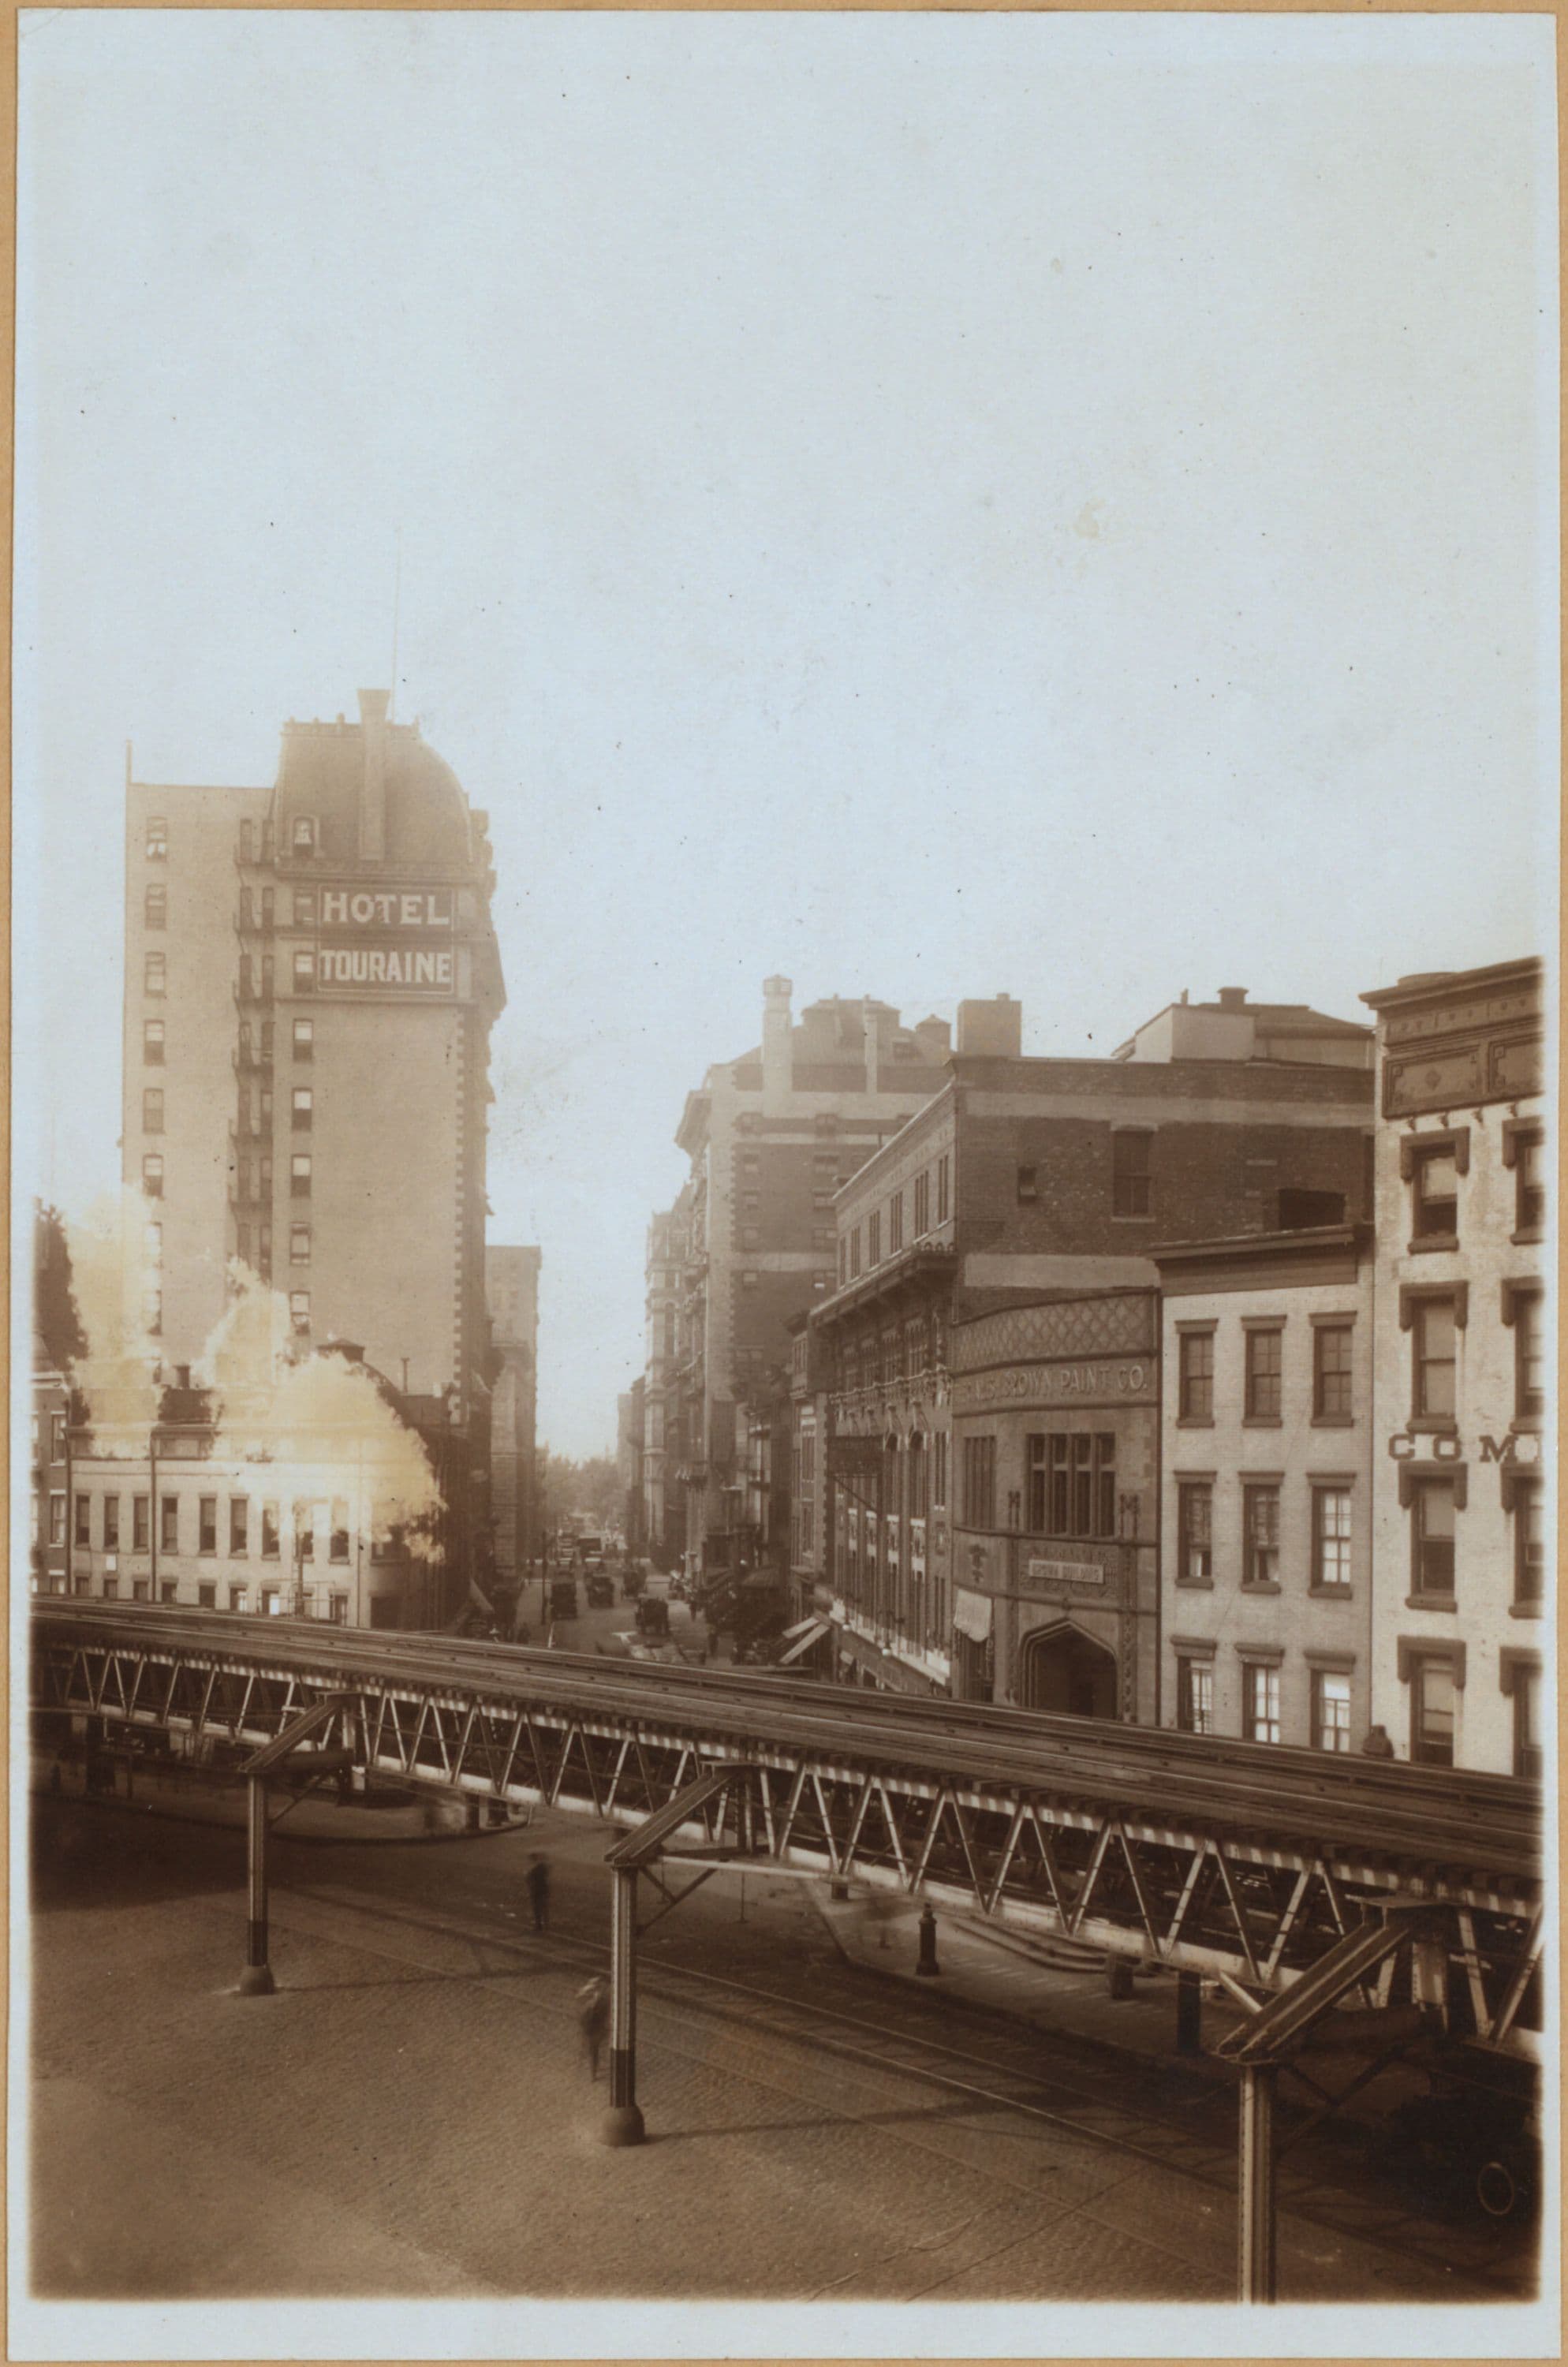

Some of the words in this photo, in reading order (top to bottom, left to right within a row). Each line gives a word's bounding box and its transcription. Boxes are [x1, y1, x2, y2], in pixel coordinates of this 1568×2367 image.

[323, 892, 449, 925] HOTEL
[320, 950, 452, 984] TOURAINE
[1060, 1367, 1110, 1395] PAINT
[1117, 1365, 1148, 1392] CO.
[1388, 1433, 1542, 1463] COM
